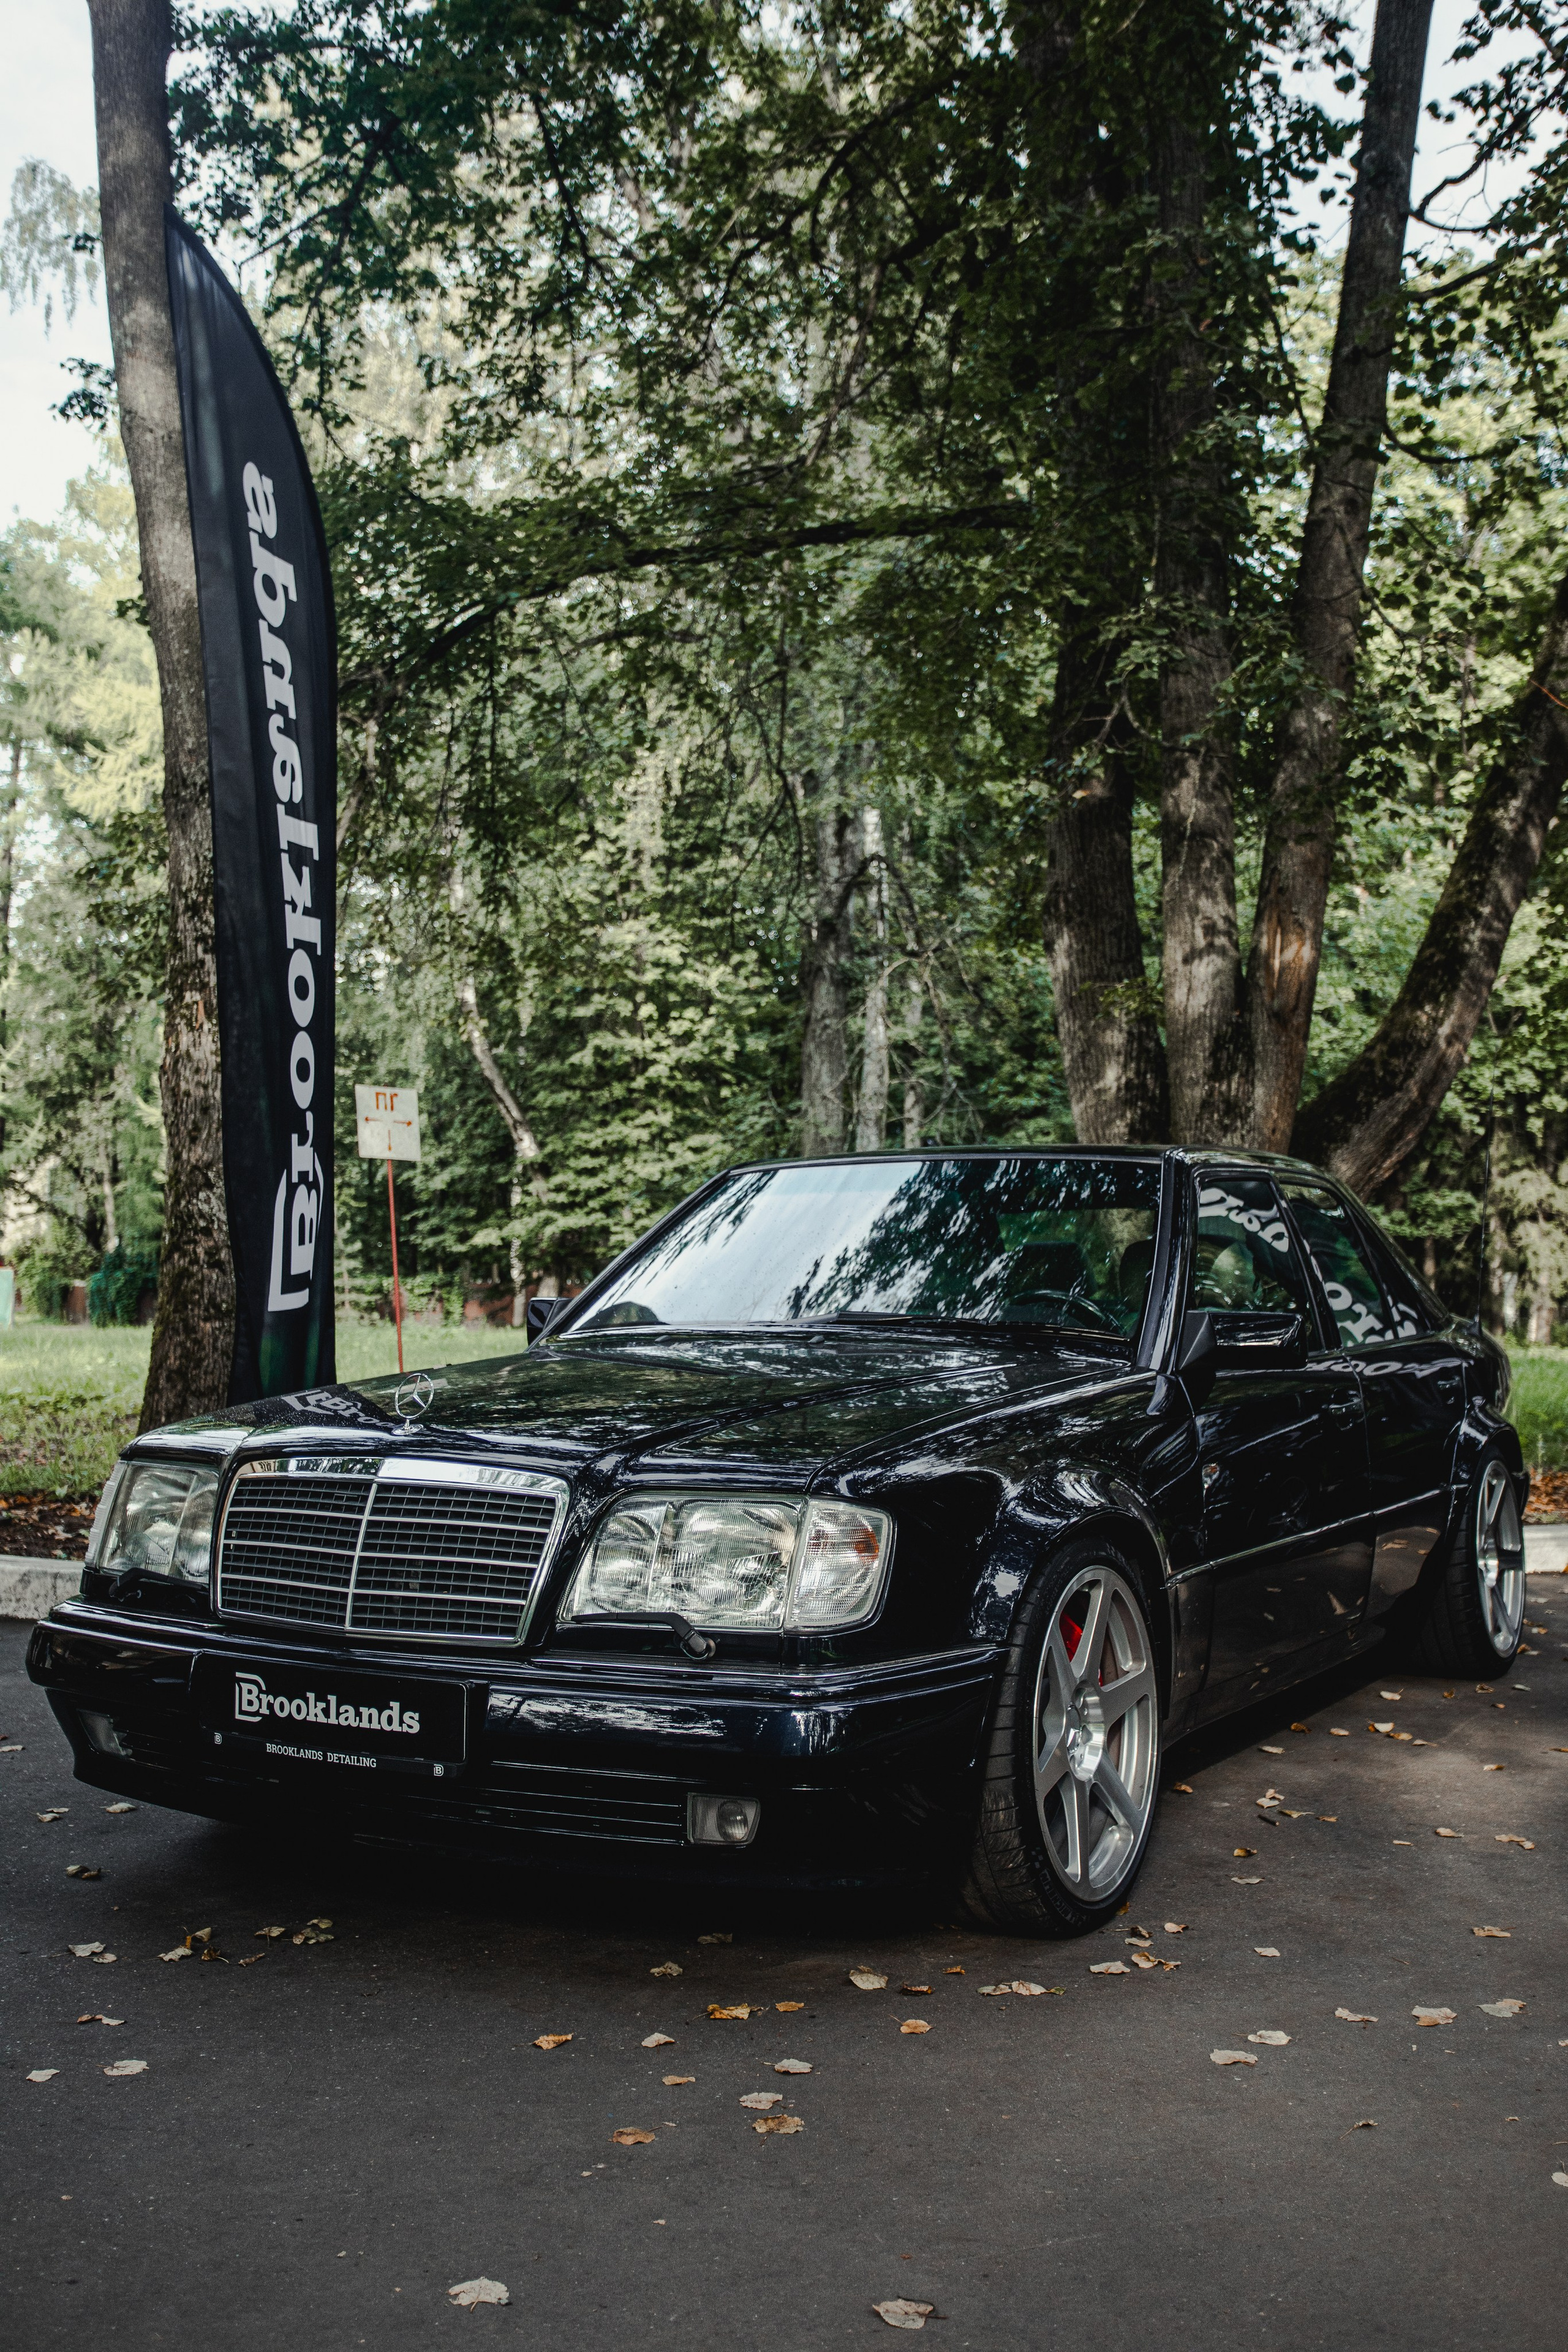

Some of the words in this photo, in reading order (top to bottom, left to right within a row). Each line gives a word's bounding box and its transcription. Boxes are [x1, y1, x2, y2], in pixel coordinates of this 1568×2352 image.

[235, 1672, 420, 1734] Brooklands
[266, 1743, 323, 1761] BROOKLANDS
[327, 1752, 377, 1768] DETAILING
